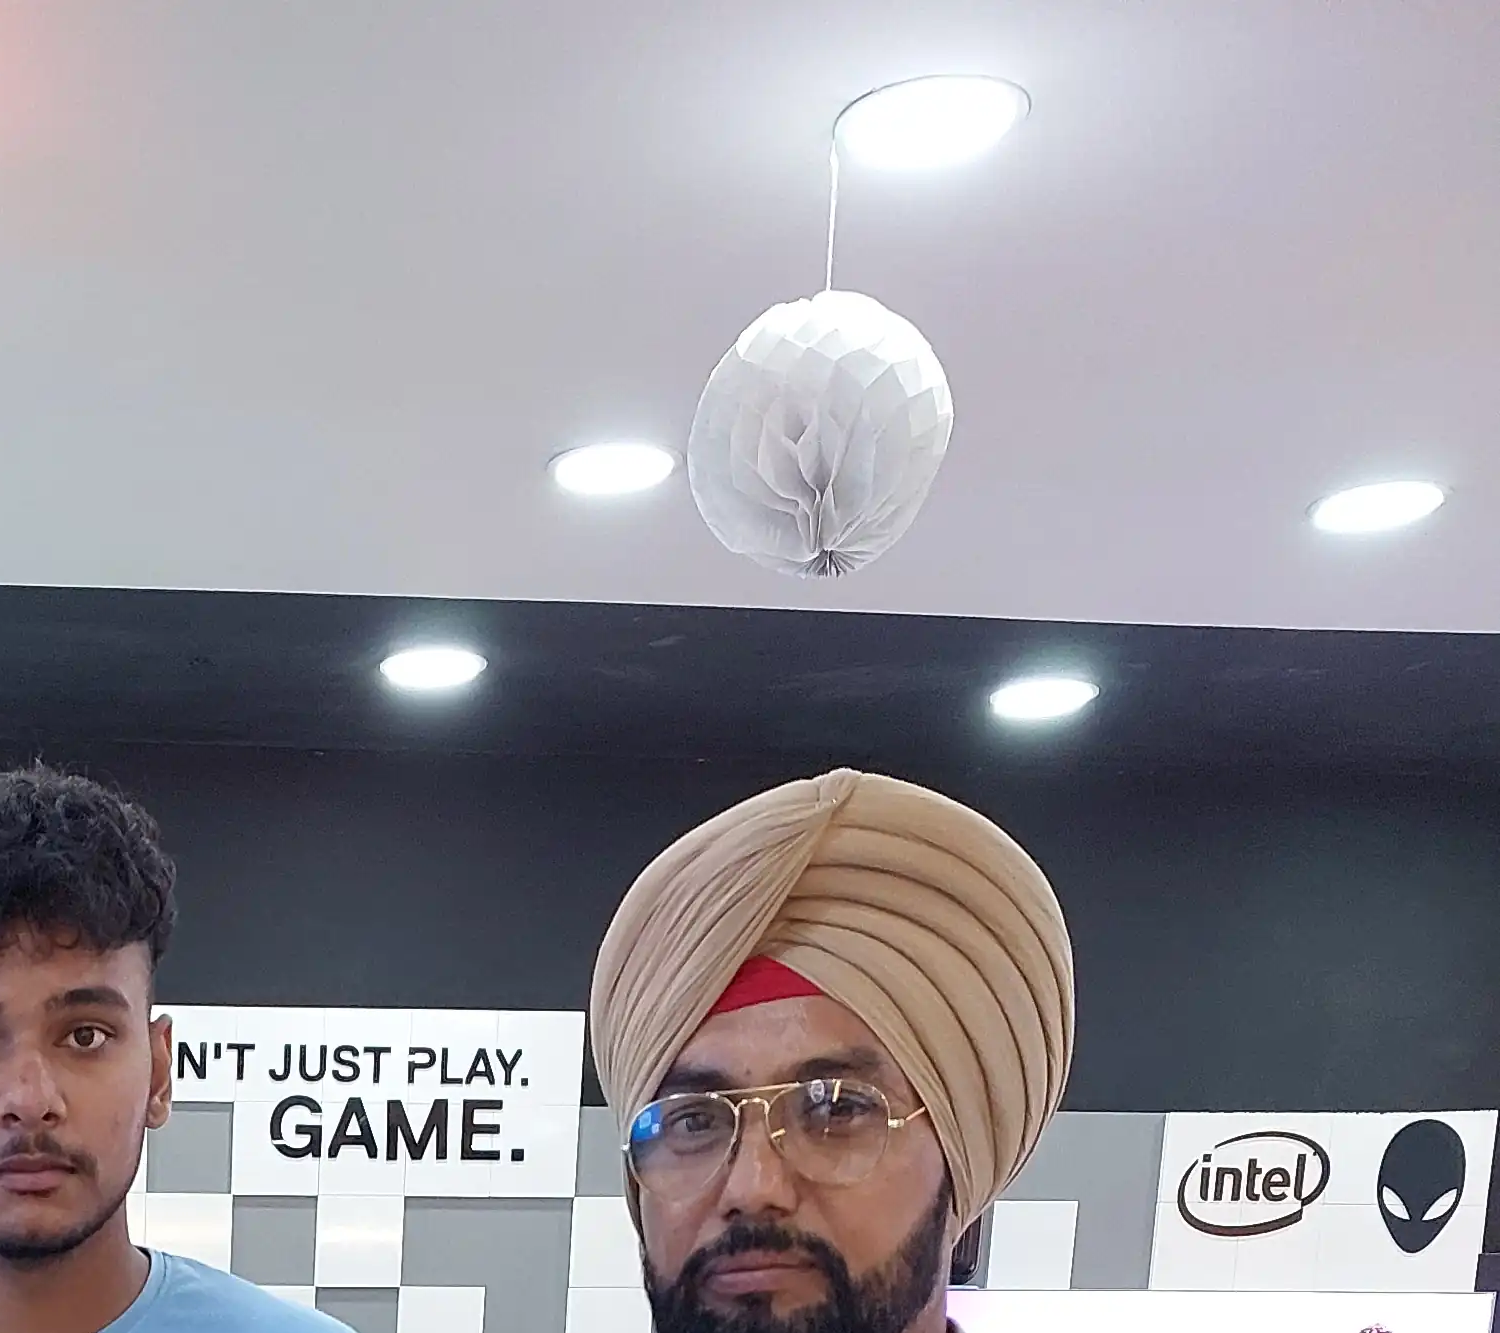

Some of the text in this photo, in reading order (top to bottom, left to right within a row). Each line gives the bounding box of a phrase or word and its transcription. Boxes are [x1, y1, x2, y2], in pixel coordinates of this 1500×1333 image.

[268, 1044, 391, 1084] JUST
[407, 1047, 529, 1086] PLAY.
[269, 1095, 525, 1161] GAME.
[1199, 1153, 1307, 1202] intel
